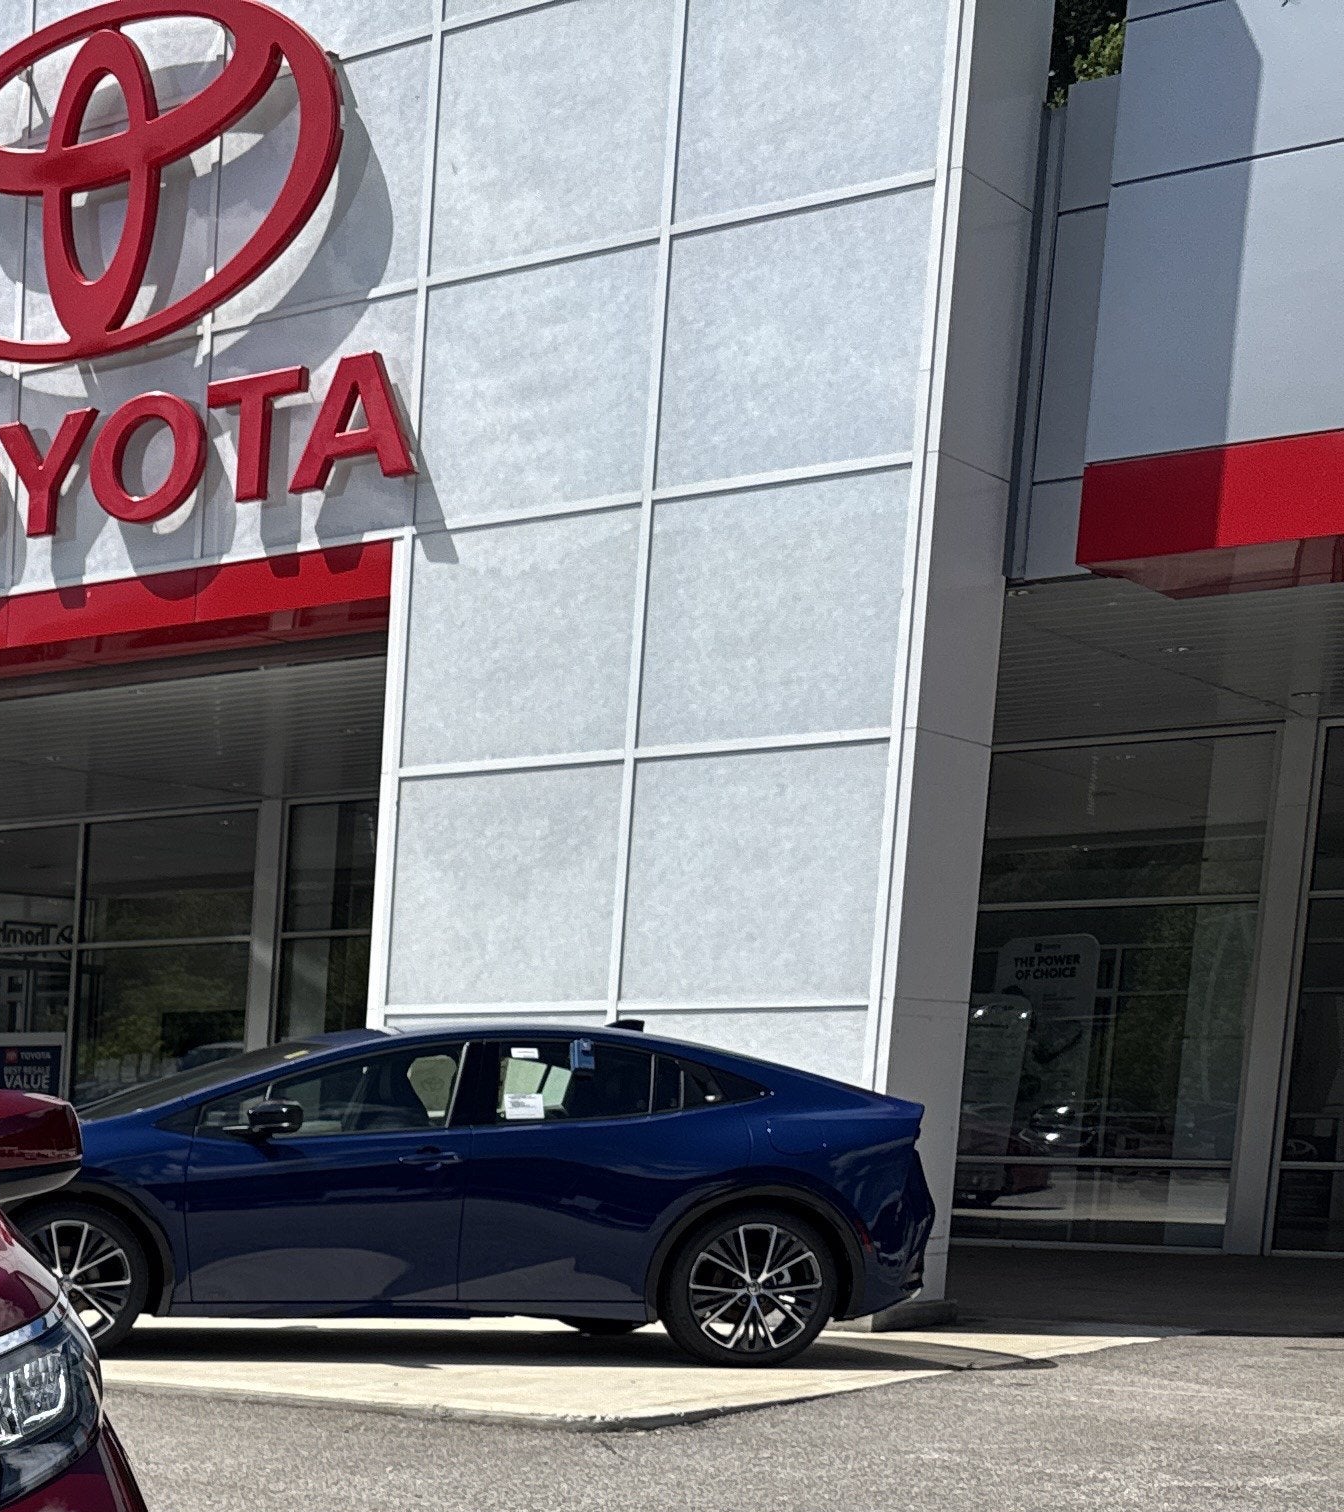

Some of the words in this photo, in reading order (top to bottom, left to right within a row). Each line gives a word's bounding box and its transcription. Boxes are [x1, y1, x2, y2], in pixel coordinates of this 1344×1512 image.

[1014, 956, 1035, 967] THE
[1038, 953, 1081, 967] POWER
[1015, 969, 1031, 980] OF
[1033, 966, 1077, 980] CHOICE
[20, 1051, 51, 1060] TOYOTA
[3, 1074, 50, 1089] VALUE
